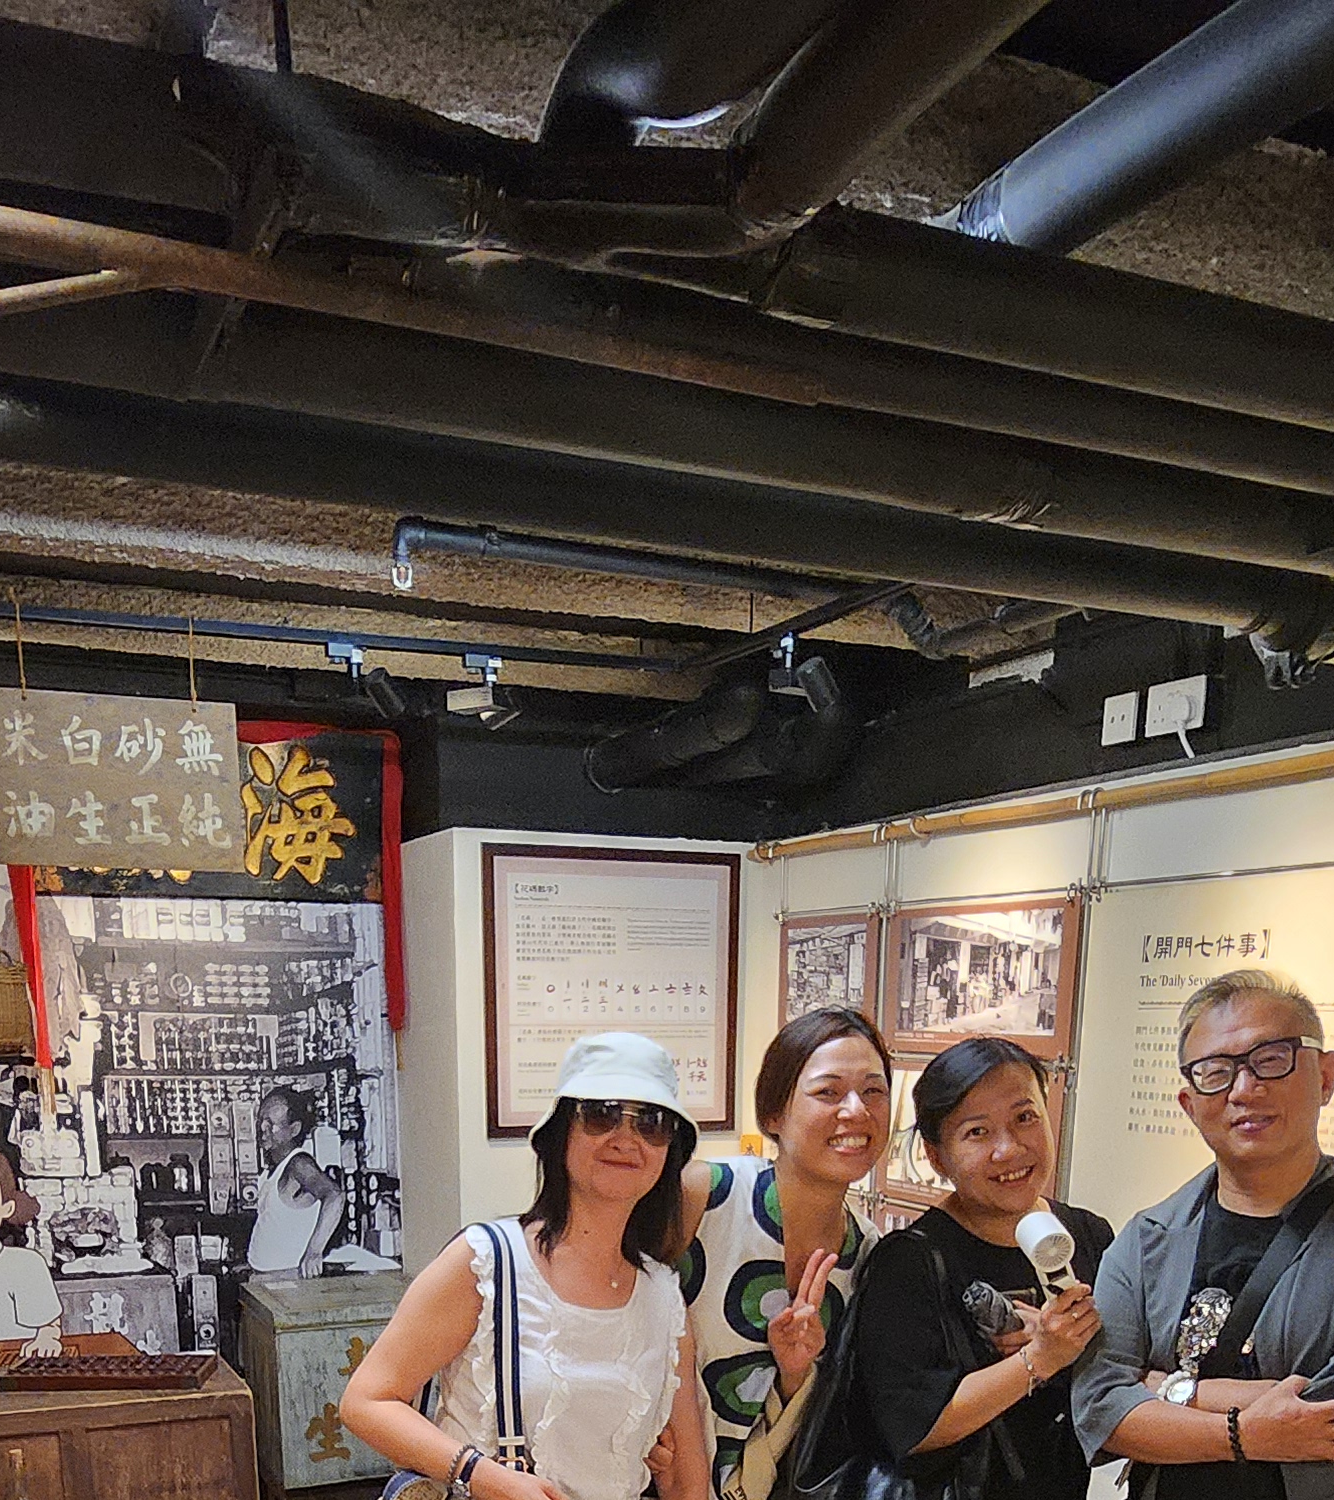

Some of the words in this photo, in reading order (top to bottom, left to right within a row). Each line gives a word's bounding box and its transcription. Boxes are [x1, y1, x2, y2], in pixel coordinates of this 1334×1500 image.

[240, 743, 356, 885] 海
[1141, 928, 1271, 963] 【開門七件事】
[1140, 975, 1157, 987] The
